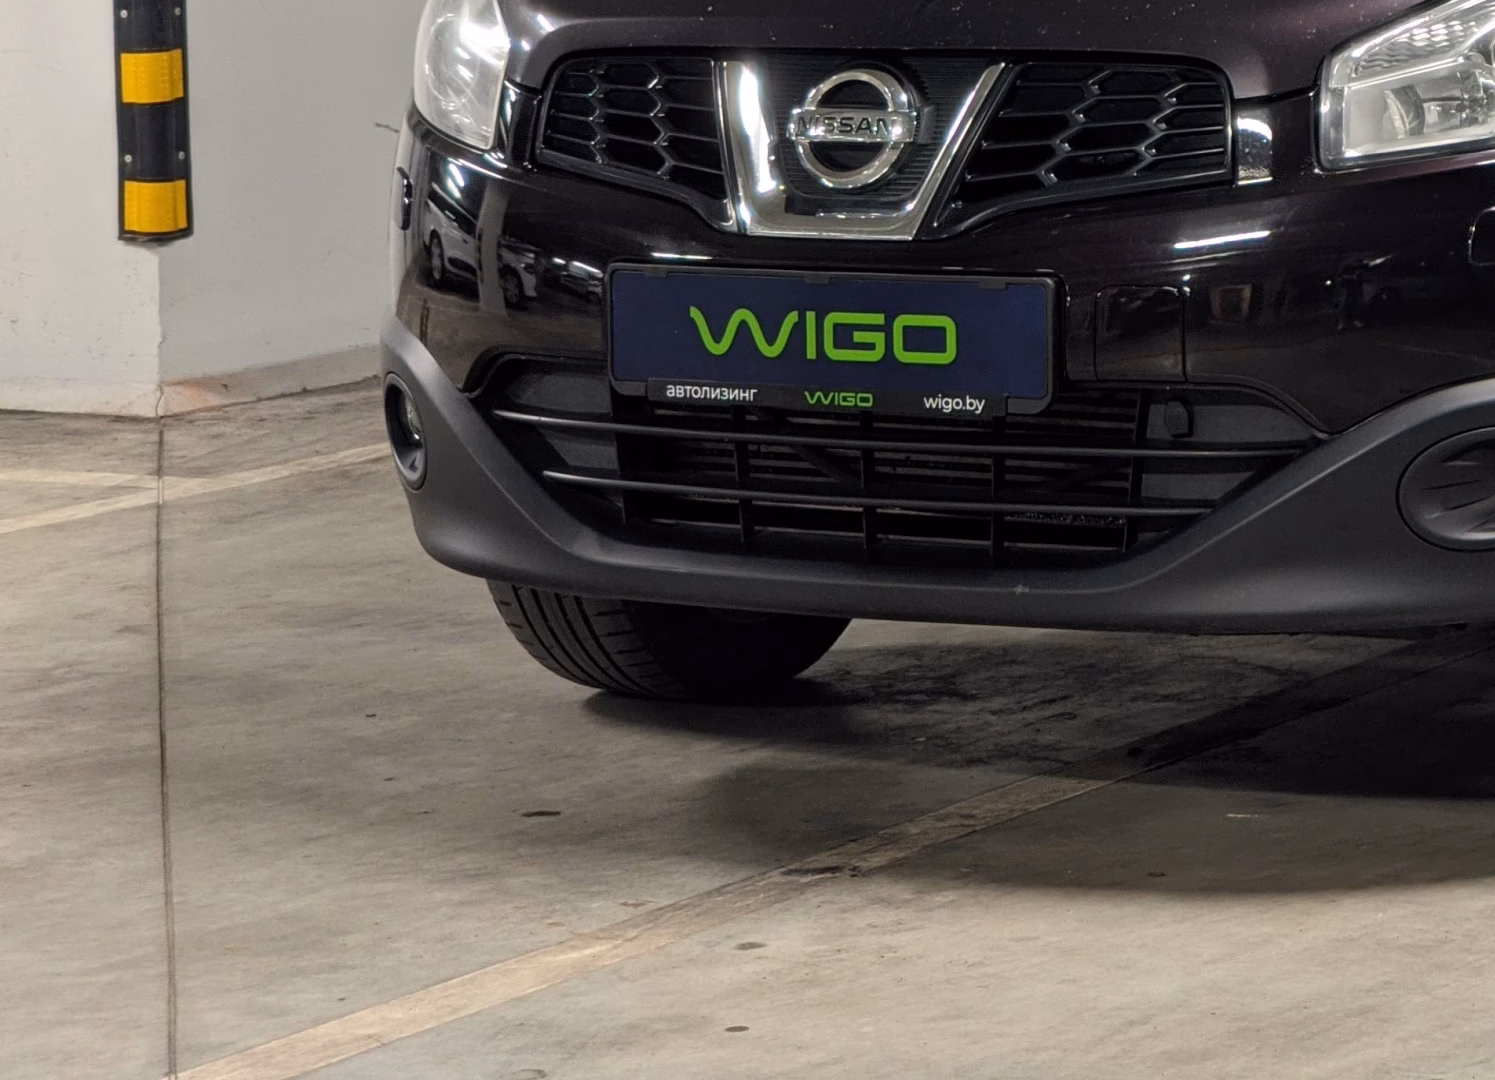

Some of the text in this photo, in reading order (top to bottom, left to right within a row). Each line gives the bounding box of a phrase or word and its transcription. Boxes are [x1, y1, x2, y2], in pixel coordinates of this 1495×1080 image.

[689, 306, 957, 365] WIGO
[666, 383, 758, 402] автолизинг
[804, 390, 873, 407] WIGO
[923, 394, 986, 414] wigo.by
